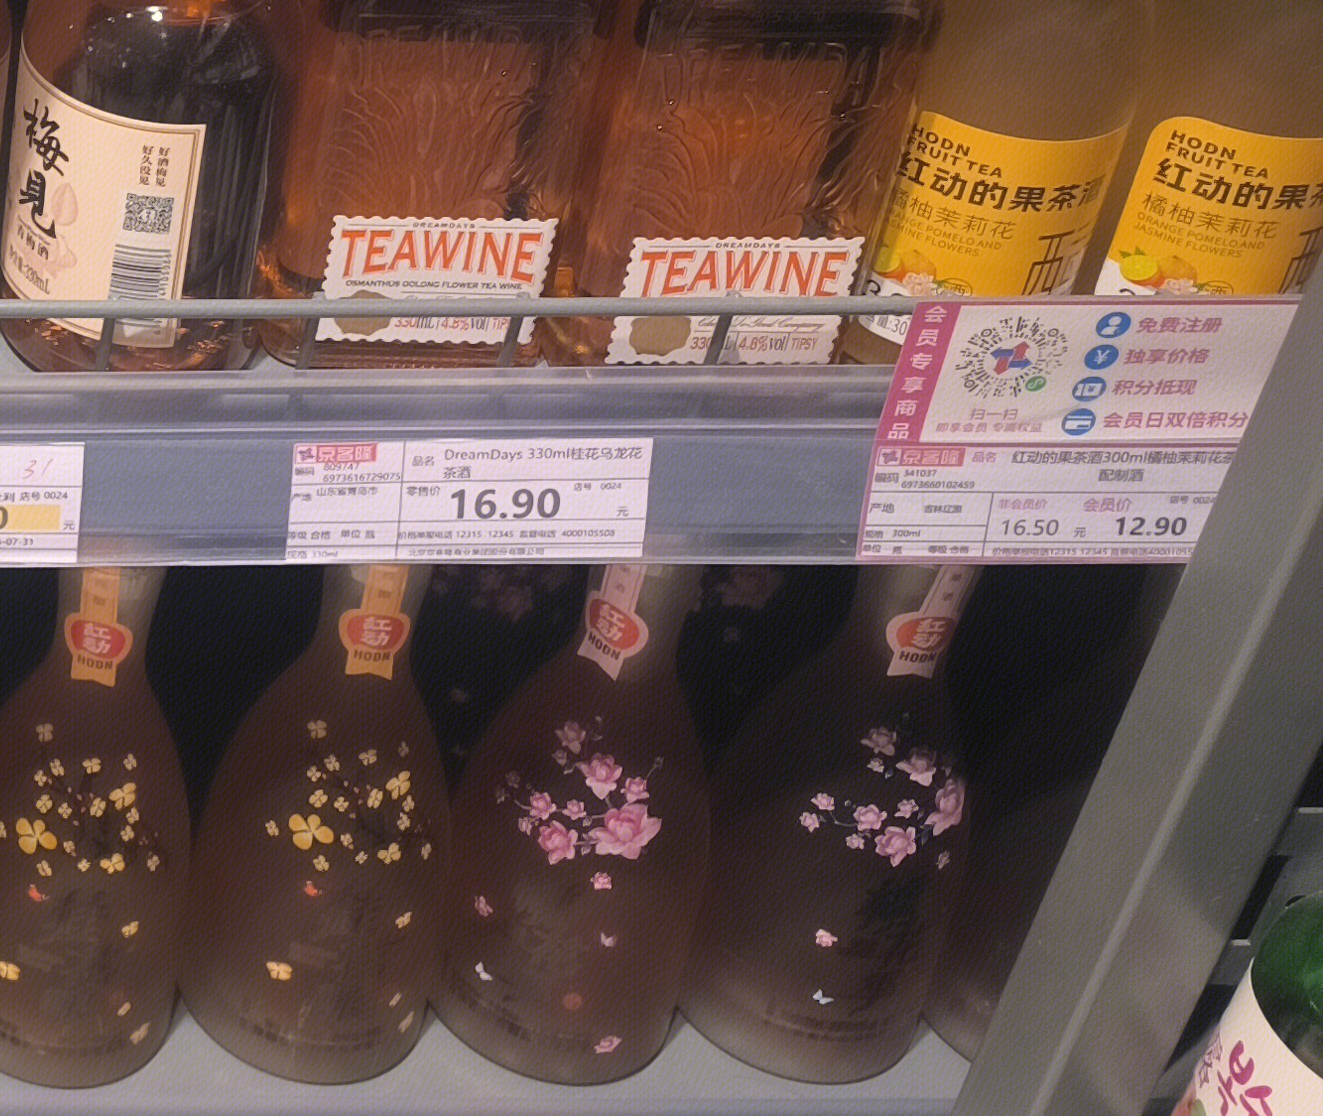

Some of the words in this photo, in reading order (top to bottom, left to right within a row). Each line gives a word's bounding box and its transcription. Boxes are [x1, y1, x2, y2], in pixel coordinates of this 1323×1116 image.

[911, 124, 971, 156] HODN
[1170, 130, 1236, 161] HODN
[907, 137, 961, 166] FRUIT
[966, 160, 1003, 178] TEA
[1166, 142, 1227, 170] FRUIT
[1232, 160, 1269, 179] TEA
[894, 152, 1107, 213] 红动的果茶酒
[1142, 190, 1282, 240] 橘柚茉莉花
[1132, 221, 1182, 248] JASMINE
[1183, 235, 1244, 259] FLOWERS
[1137, 212, 1185, 236] ORANGE
[1186, 225, 1237, 248] POMELO
[1240, 239, 1266, 250] AND
[342, 229, 544, 283] TEAWINE
[641, 251, 848, 298] TEAWINE
[1137, 317, 1222, 334] 免费注册
[791, 336, 819, 351] TIPSY
[1125, 349, 1210, 365] 独享价格
[887, 305, 948, 440] 会员专享商品
[1112, 379, 1196, 395] 积分抵现
[1103, 412, 1249, 429] 会员日双倍积分
[445, 448, 522, 462] DreamDays
[451, 488, 561, 520] 16.90
[1002, 518, 1059, 537] 16.50
[1115, 517, 1187, 536] 12.90
[77, 655, 114, 671] HODN
[353, 649, 391, 663] HODN
[899, 650, 937, 664] HODN
